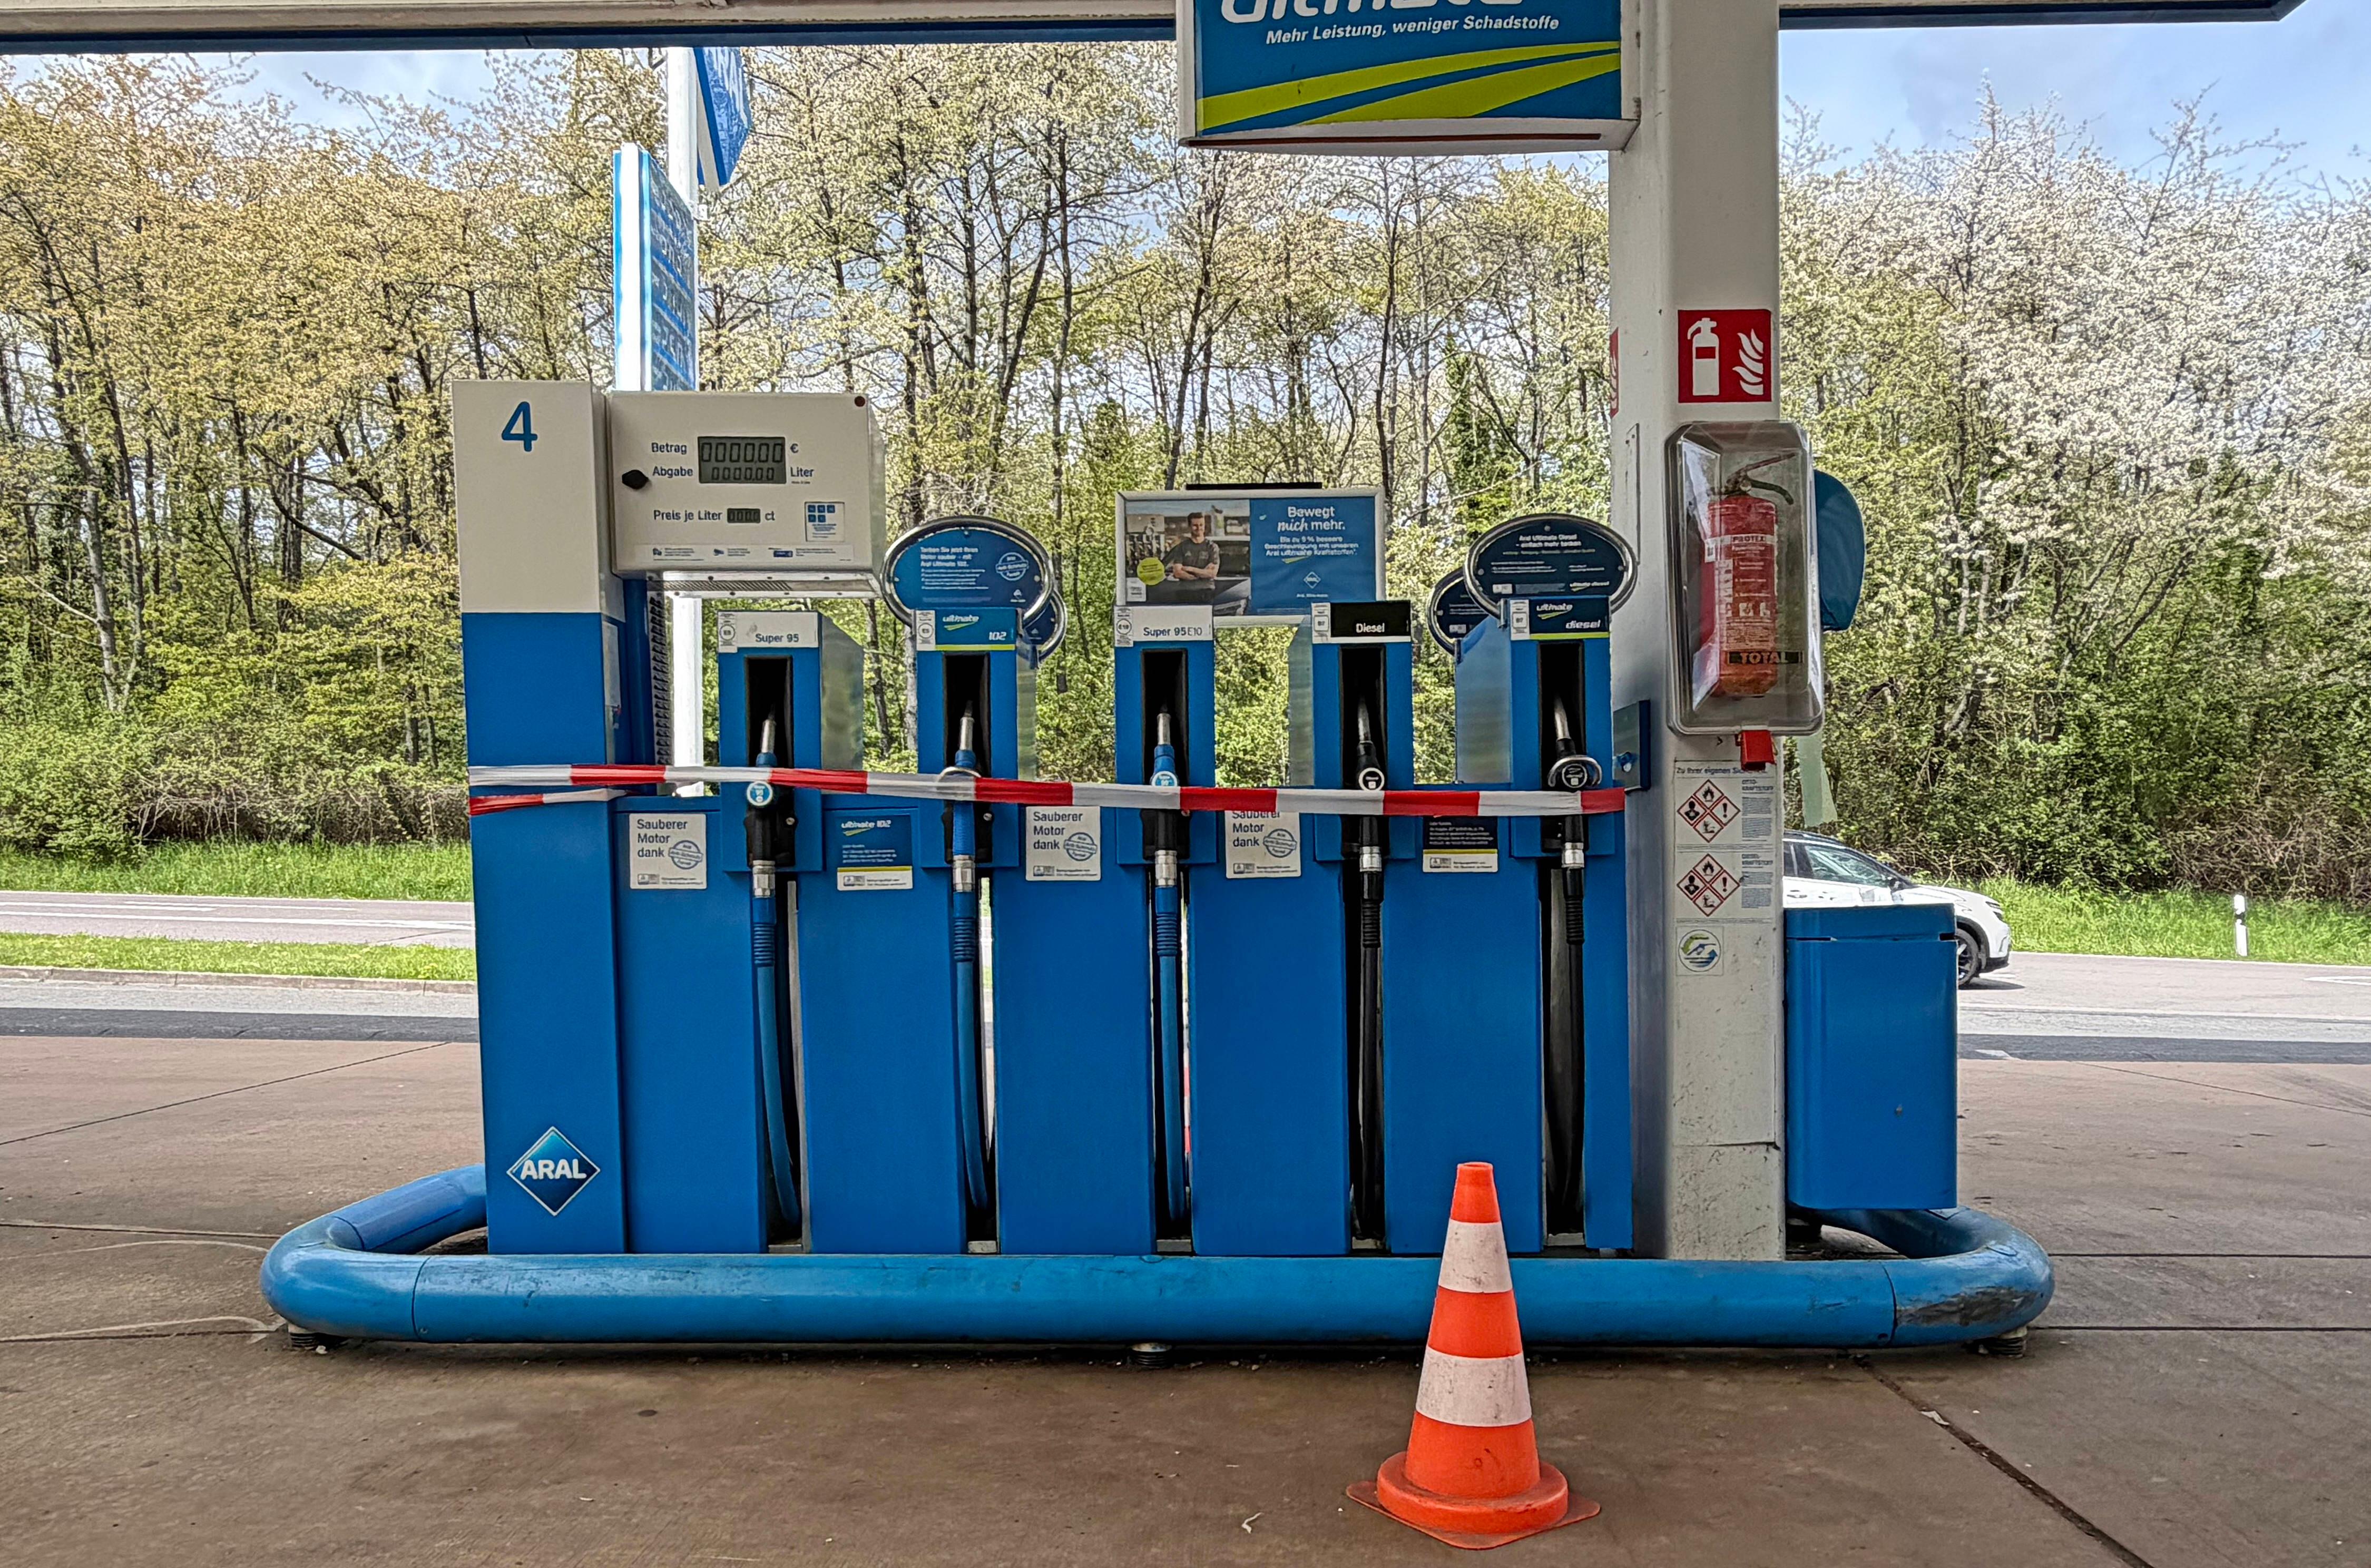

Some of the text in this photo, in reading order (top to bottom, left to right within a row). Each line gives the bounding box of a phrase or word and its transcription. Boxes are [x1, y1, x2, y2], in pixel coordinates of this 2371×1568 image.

[1266, 15, 1560, 45] Mehr Leistung, weniger Schadstoffe
[501, 401, 538, 452] 4
[651, 442, 688, 455] Betrag
[790, 443, 799, 453] €
[652, 466, 693, 478] Abgabe
[790, 466, 815, 477] Liter
[653, 509, 723, 522] Preis je Liter
[765, 511, 776, 521] ct
[1287, 506, 1335, 518] Bewegt
[1277, 517, 1345, 532] mich mehr.
[1356, 622, 1385, 633] Diesel
[1565, 620, 1601, 629] diesel
[989, 631, 1007, 640] 102
[1143, 627, 1171, 637] Super
[755, 634, 799, 643] Super 95
[1740, 652, 1789, 664] TOTAL
[1033, 811, 1083, 821] Sauberer
[636, 819, 688, 829] Sauberer
[1233, 823, 1265, 832] Motor
[1033, 826, 1065, 835] Motor
[638, 833, 671, 843] Motor
[1233, 837, 1259, 847] dank
[1033, 839, 1060, 850] dank
[638, 847, 665, 857] dank
[520, 1159, 587, 1180] ARAL
